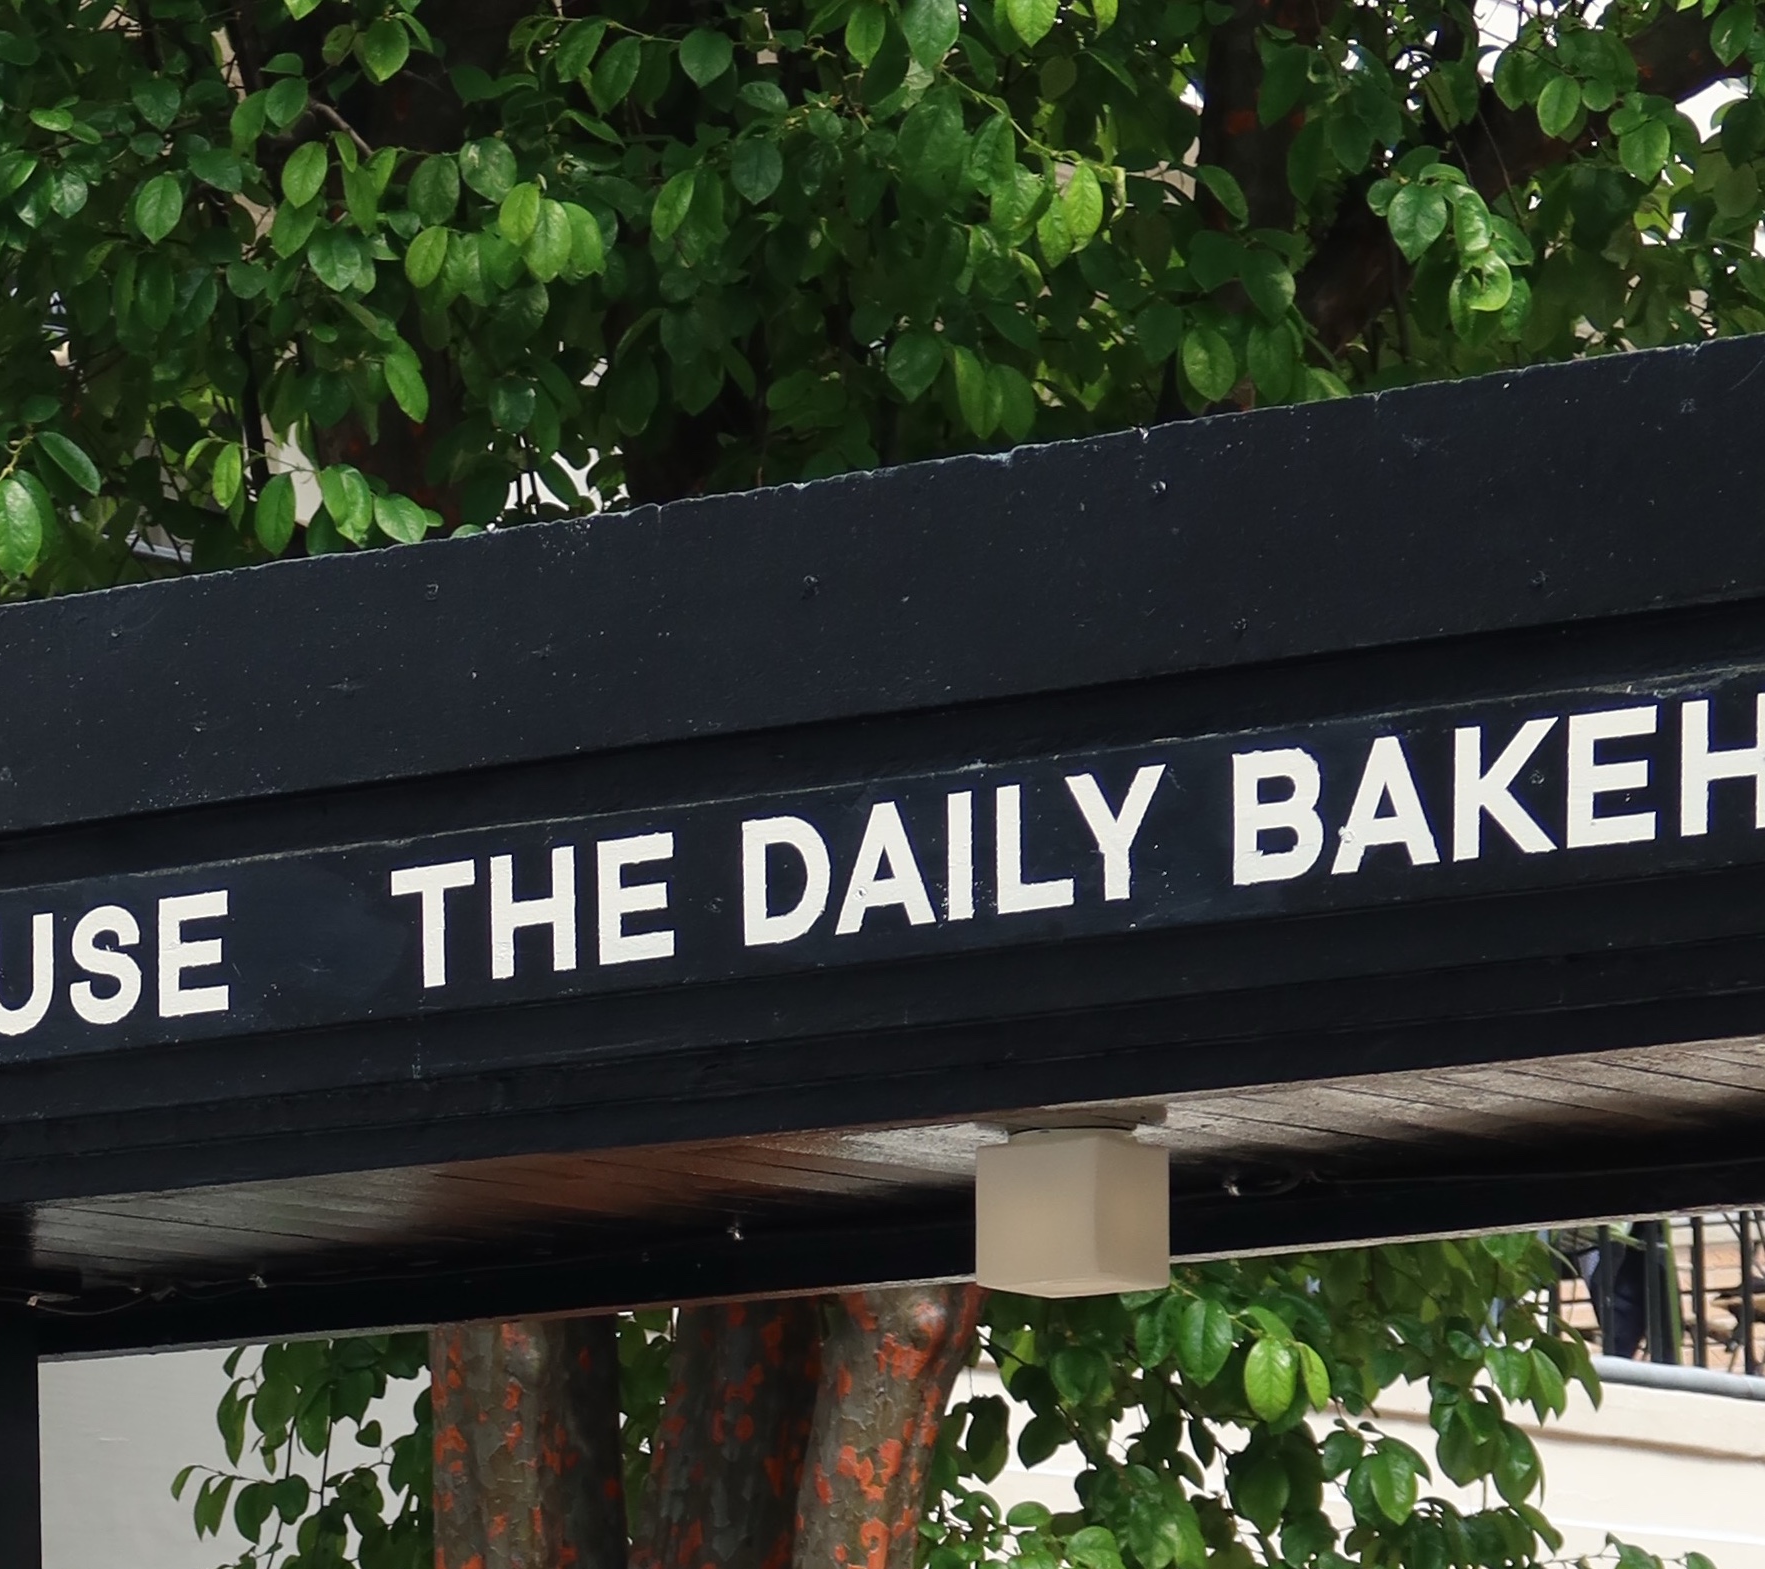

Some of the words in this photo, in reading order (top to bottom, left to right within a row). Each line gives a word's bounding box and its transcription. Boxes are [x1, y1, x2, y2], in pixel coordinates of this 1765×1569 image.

[390, 831, 675, 989] THE
[741, 763, 1167, 947] DAILY
[1231, 692, 1765, 886] BAKEH
